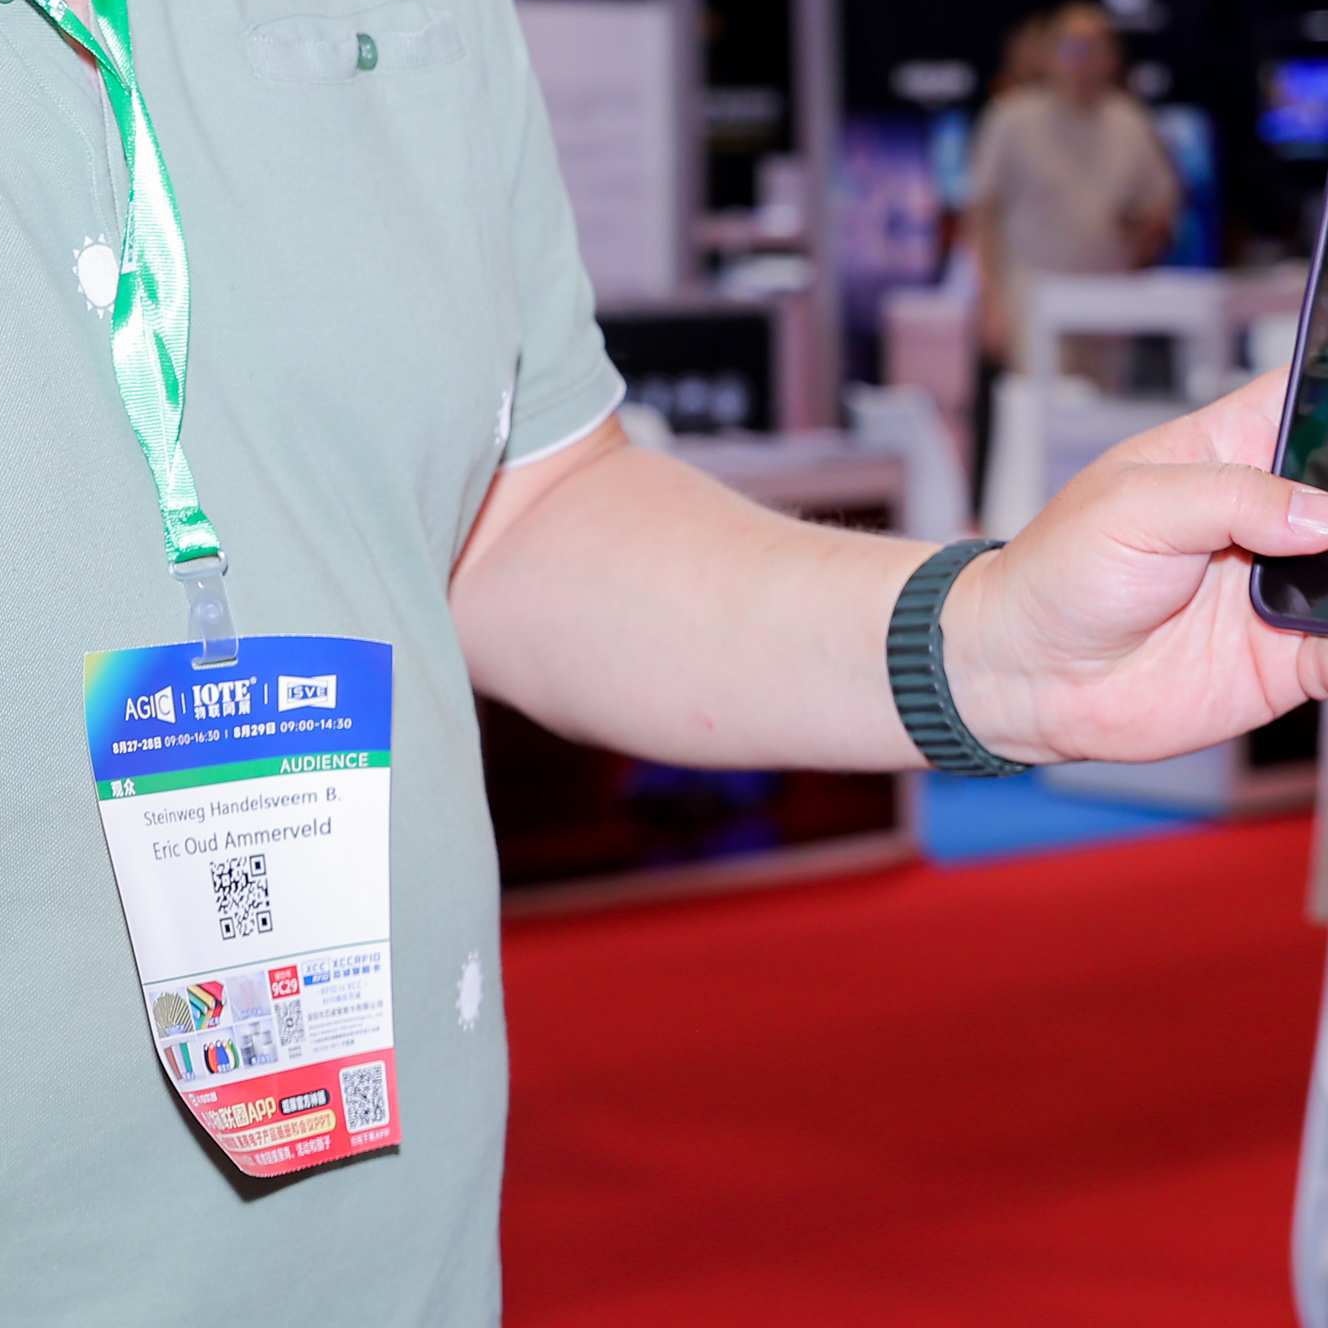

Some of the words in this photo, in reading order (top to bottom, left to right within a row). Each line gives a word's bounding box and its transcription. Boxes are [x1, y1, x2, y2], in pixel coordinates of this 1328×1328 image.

[125, 685, 176, 724] AGIC
[279, 752, 370, 774] AUDIENCE
[143, 806, 207, 827] Steinweg
[210, 789, 319, 818] Handelsveem
[152, 839, 182, 862] Eric
[184, 833, 219, 856] Oud
[224, 816, 333, 851] Ammerveld
